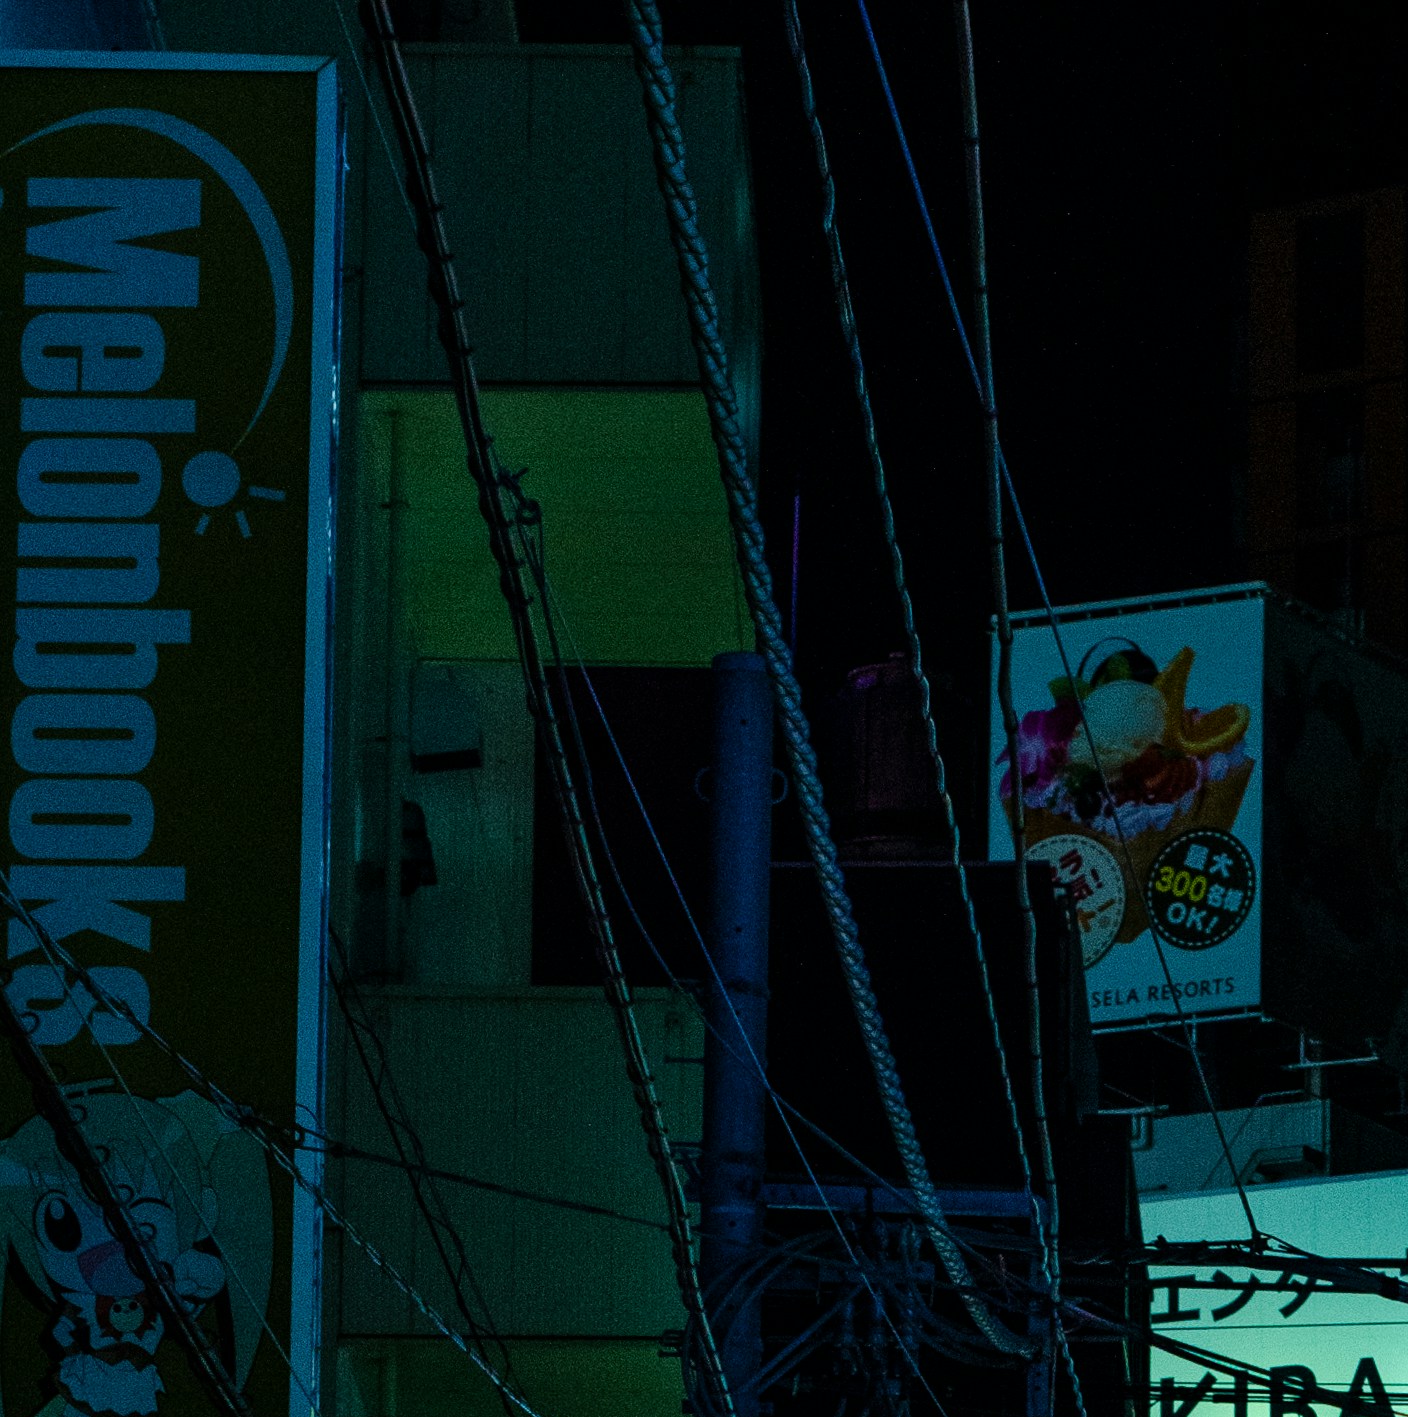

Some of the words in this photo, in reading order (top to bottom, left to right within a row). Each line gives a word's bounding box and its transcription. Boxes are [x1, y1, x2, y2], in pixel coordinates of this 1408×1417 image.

[7, 176, 203, 1047] Melonbooks
[1166, 902, 1221, 935] OK!
[1147, 977, 1236, 1001] RESORTS
